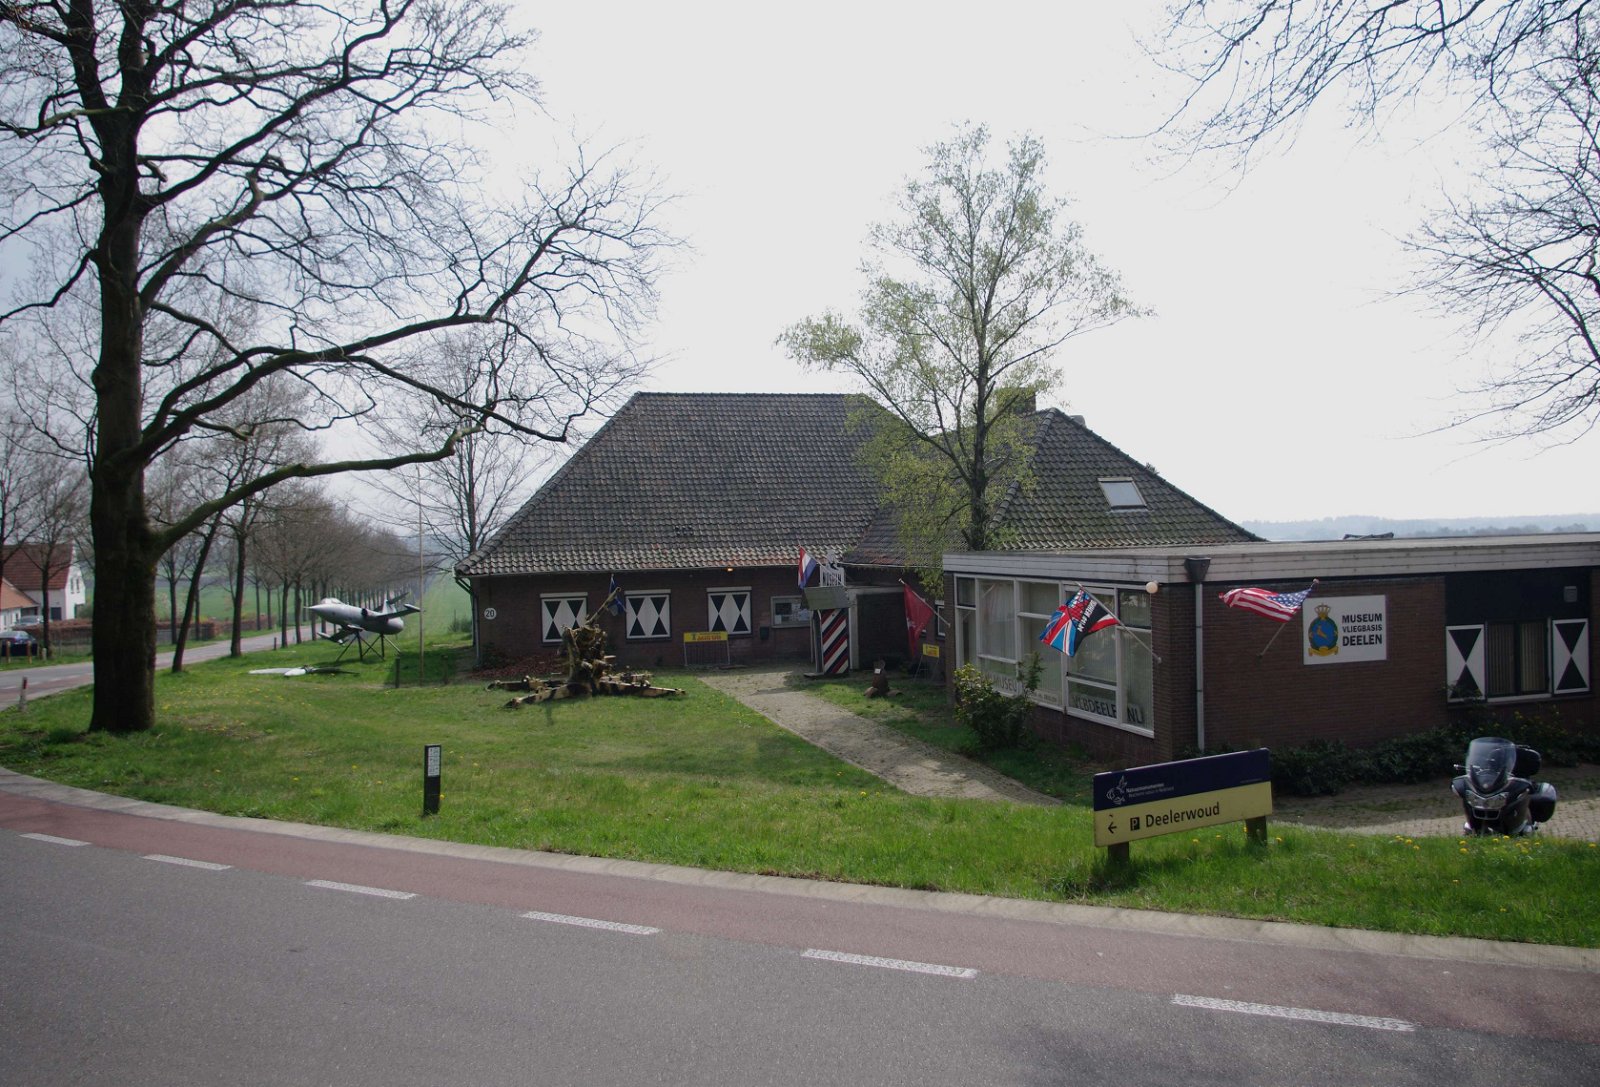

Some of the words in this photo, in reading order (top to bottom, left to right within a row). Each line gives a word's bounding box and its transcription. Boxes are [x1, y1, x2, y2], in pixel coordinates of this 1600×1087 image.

[485, 609, 495, 618] 20
[1341, 613, 1383, 623] MUSEUM
[1342, 624, 1383, 633] VLIEGBASIS
[1342, 634, 1383, 646] DEELEN
[1146, 802, 1220, 828] Deelerwoud
